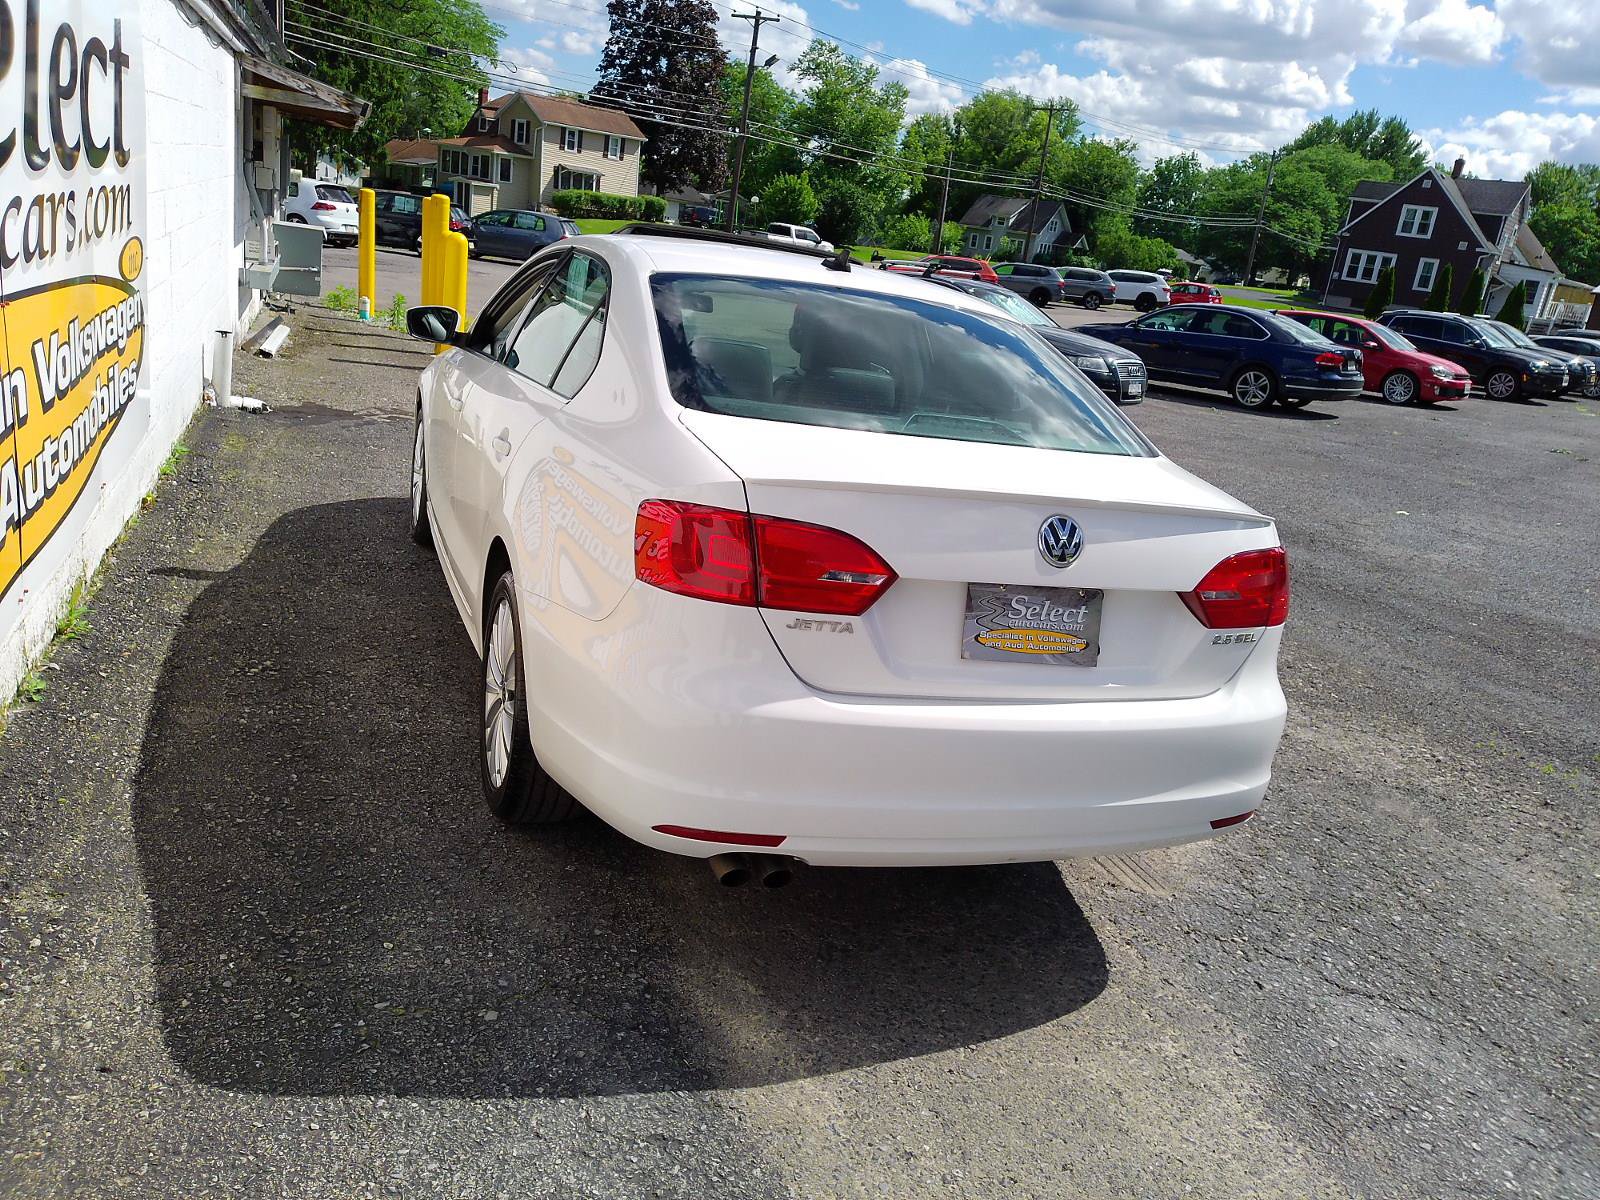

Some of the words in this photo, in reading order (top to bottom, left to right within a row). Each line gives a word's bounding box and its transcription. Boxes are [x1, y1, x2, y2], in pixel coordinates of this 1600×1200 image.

[32, 290, 143, 411] Volkswagen
[0, 358, 138, 546] Automobiles
[1007, 595, 1089, 623] Select
[786, 618, 854, 634] JETTA
[979, 630, 1024, 641] Specialist
[1036, 635, 1087, 645] Volkswagen
[984, 640, 1001, 648] and
[1003, 641, 1024, 649] Audi
[1027, 642, 1081, 652] Automobiles
